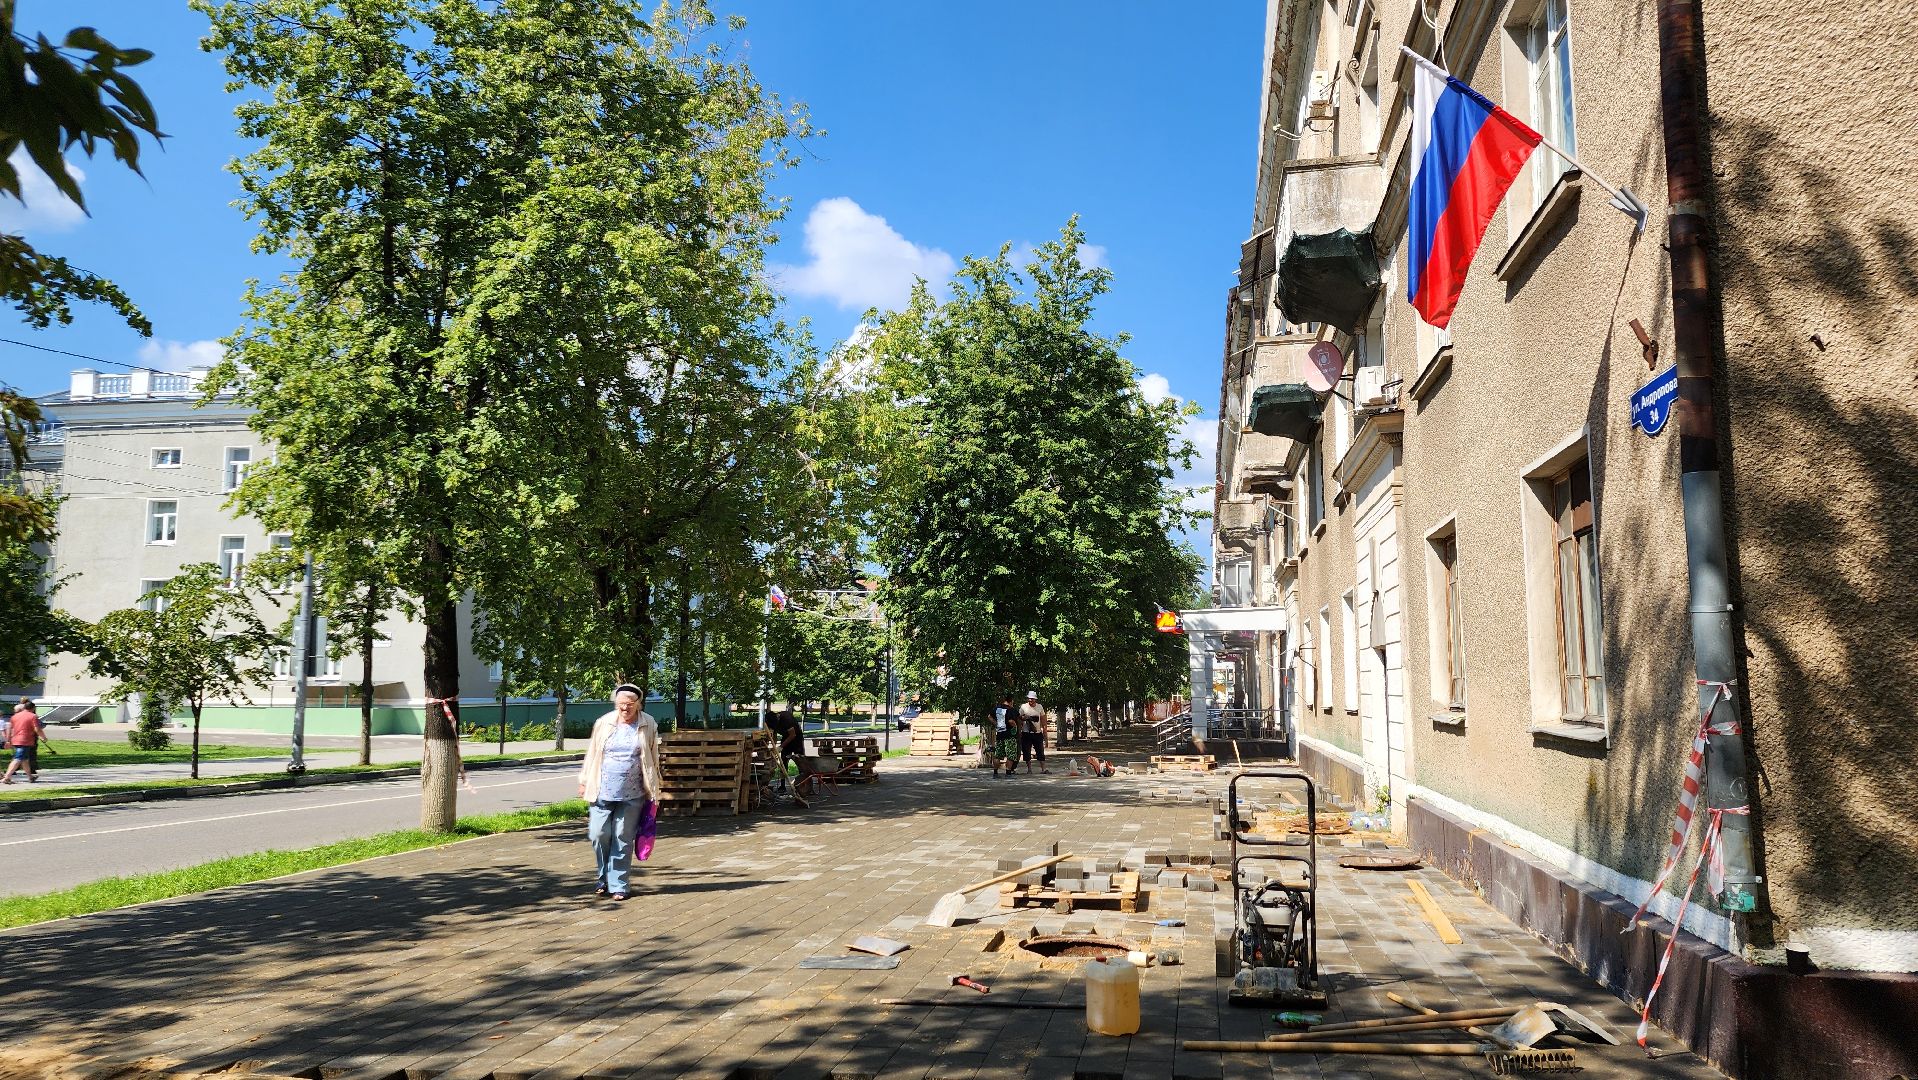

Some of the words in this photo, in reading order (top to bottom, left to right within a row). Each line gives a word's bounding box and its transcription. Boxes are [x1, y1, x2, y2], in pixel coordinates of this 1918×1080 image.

[1632, 403, 1640, 419] ул.
[1641, 378, 1678, 409] Андропова
[1649, 408, 1659, 424] 34
